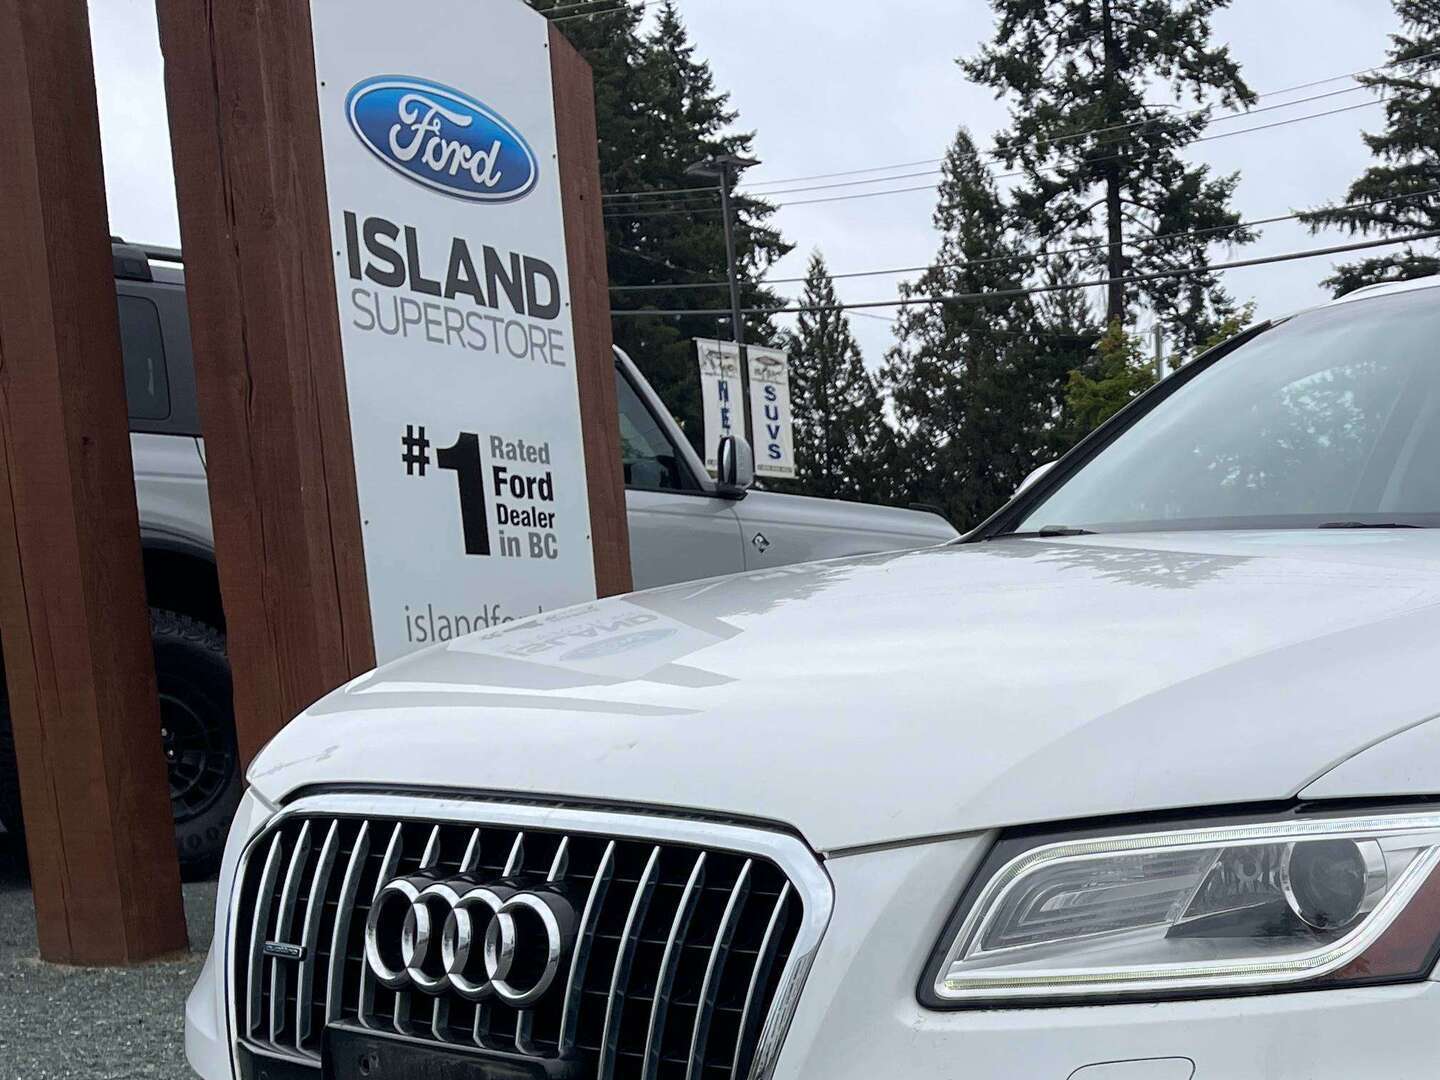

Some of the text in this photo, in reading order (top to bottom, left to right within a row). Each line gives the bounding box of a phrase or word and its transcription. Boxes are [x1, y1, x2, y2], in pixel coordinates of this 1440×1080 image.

[389, 93, 502, 187] Ford
[343, 210, 560, 320] ISLAND
[351, 287, 567, 367] SUPERSTORE
[489, 435, 550, 465] Rated
[764, 385, 782, 460] SUVS
[401, 424, 491, 556] #1
[492, 465, 554, 501] Ford
[496, 503, 556, 529] Dealer
[499, 530, 559, 560] in BC
